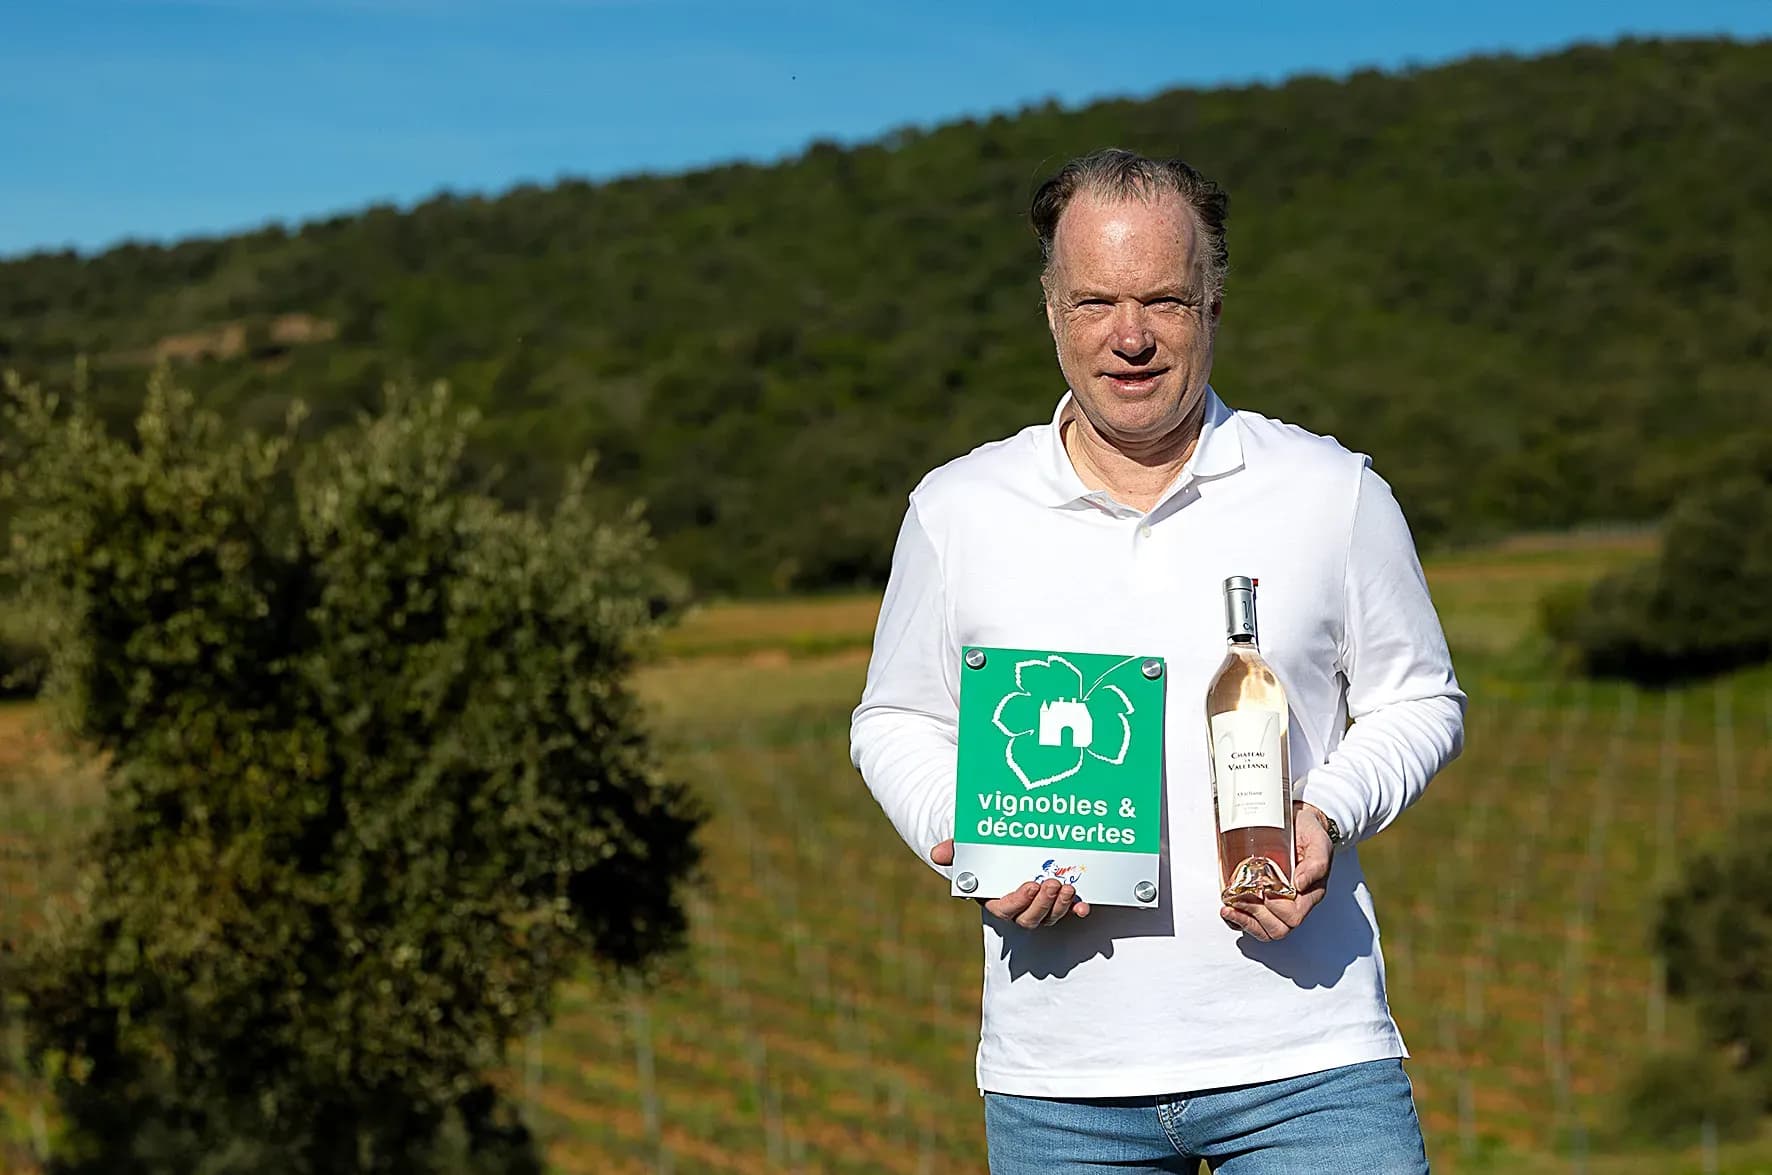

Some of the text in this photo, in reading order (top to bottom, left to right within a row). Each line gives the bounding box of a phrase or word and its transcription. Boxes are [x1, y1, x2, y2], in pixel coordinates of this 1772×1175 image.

[977, 791, 1137, 818] vignobles &
[976, 816, 1136, 845] découvertes
